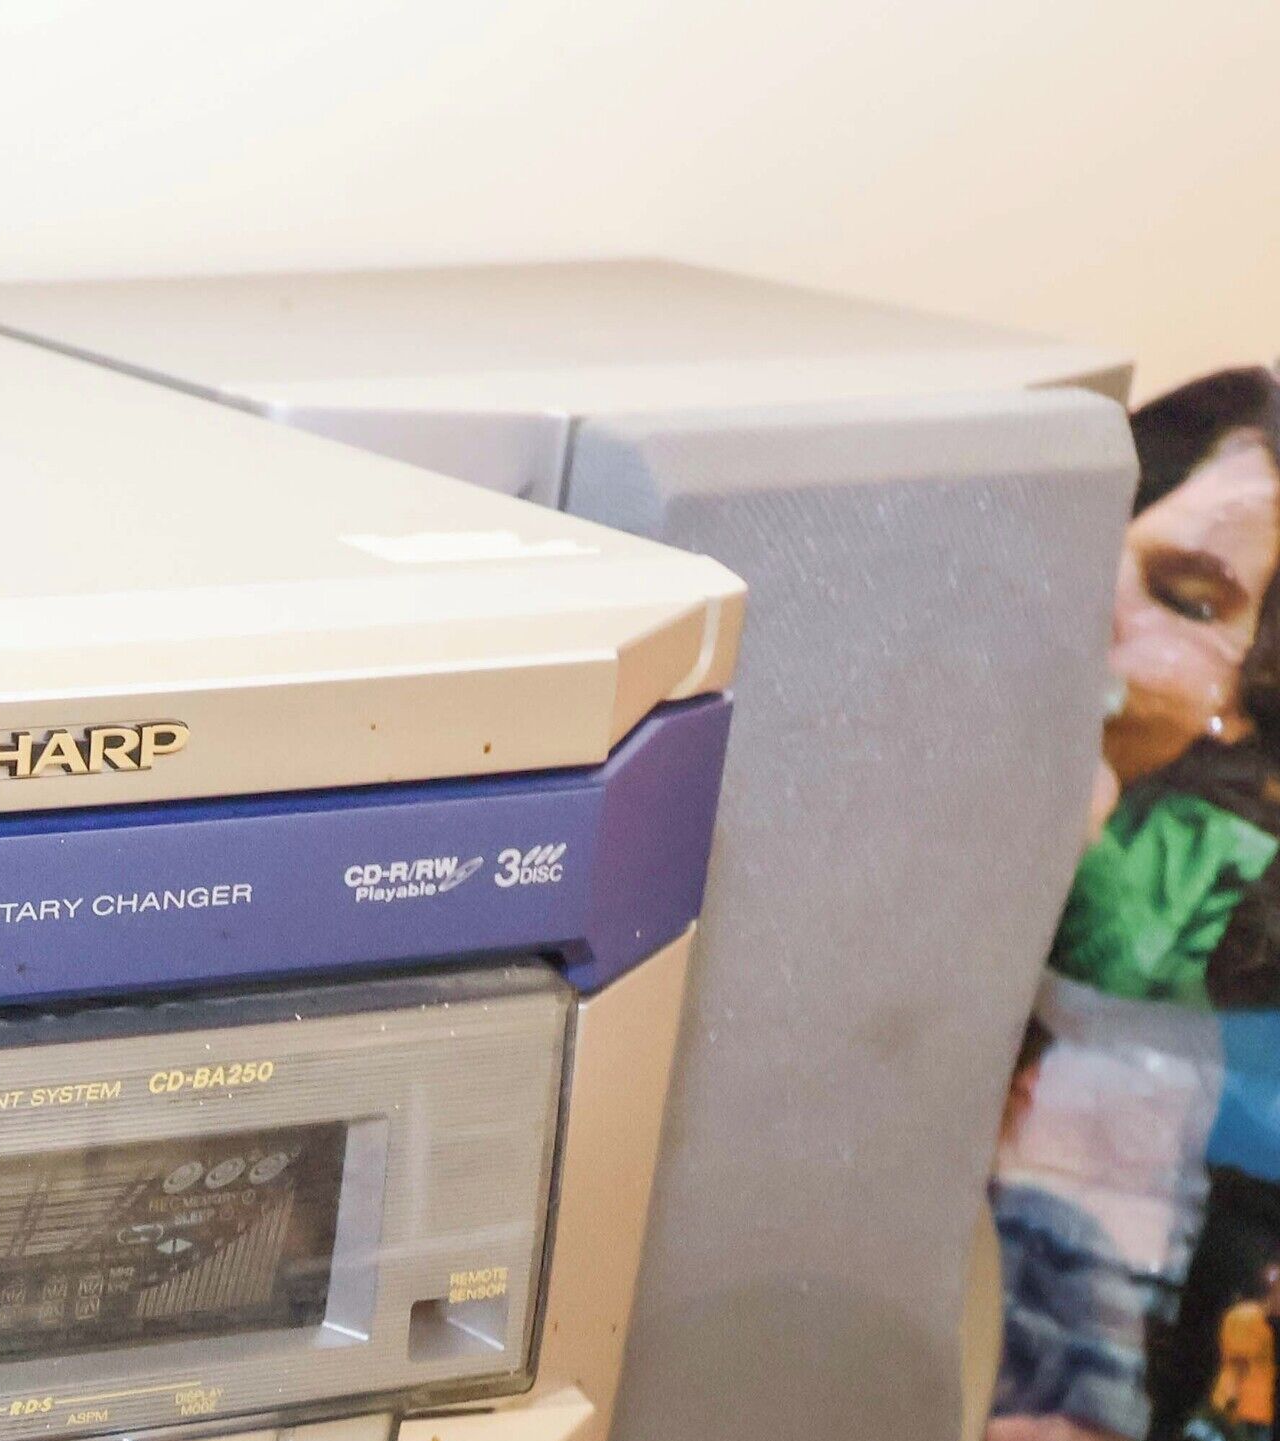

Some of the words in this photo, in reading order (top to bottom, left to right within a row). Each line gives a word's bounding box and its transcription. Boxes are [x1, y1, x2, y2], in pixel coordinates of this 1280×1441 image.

[344, 857, 458, 887] CD-R/RW
[494, 848, 522, 888] 3
[519, 864, 564, 885] DISC
[92, 884, 253, 916] CHANGER
[355, 882, 437, 903] Playable
[30, 1080, 122, 1107] SYSTEM
[147, 1061, 274, 1094] CD-BA250
[175, 1388, 224, 1406] DISPLAY
[180, 1400, 216, 1416] MODE
